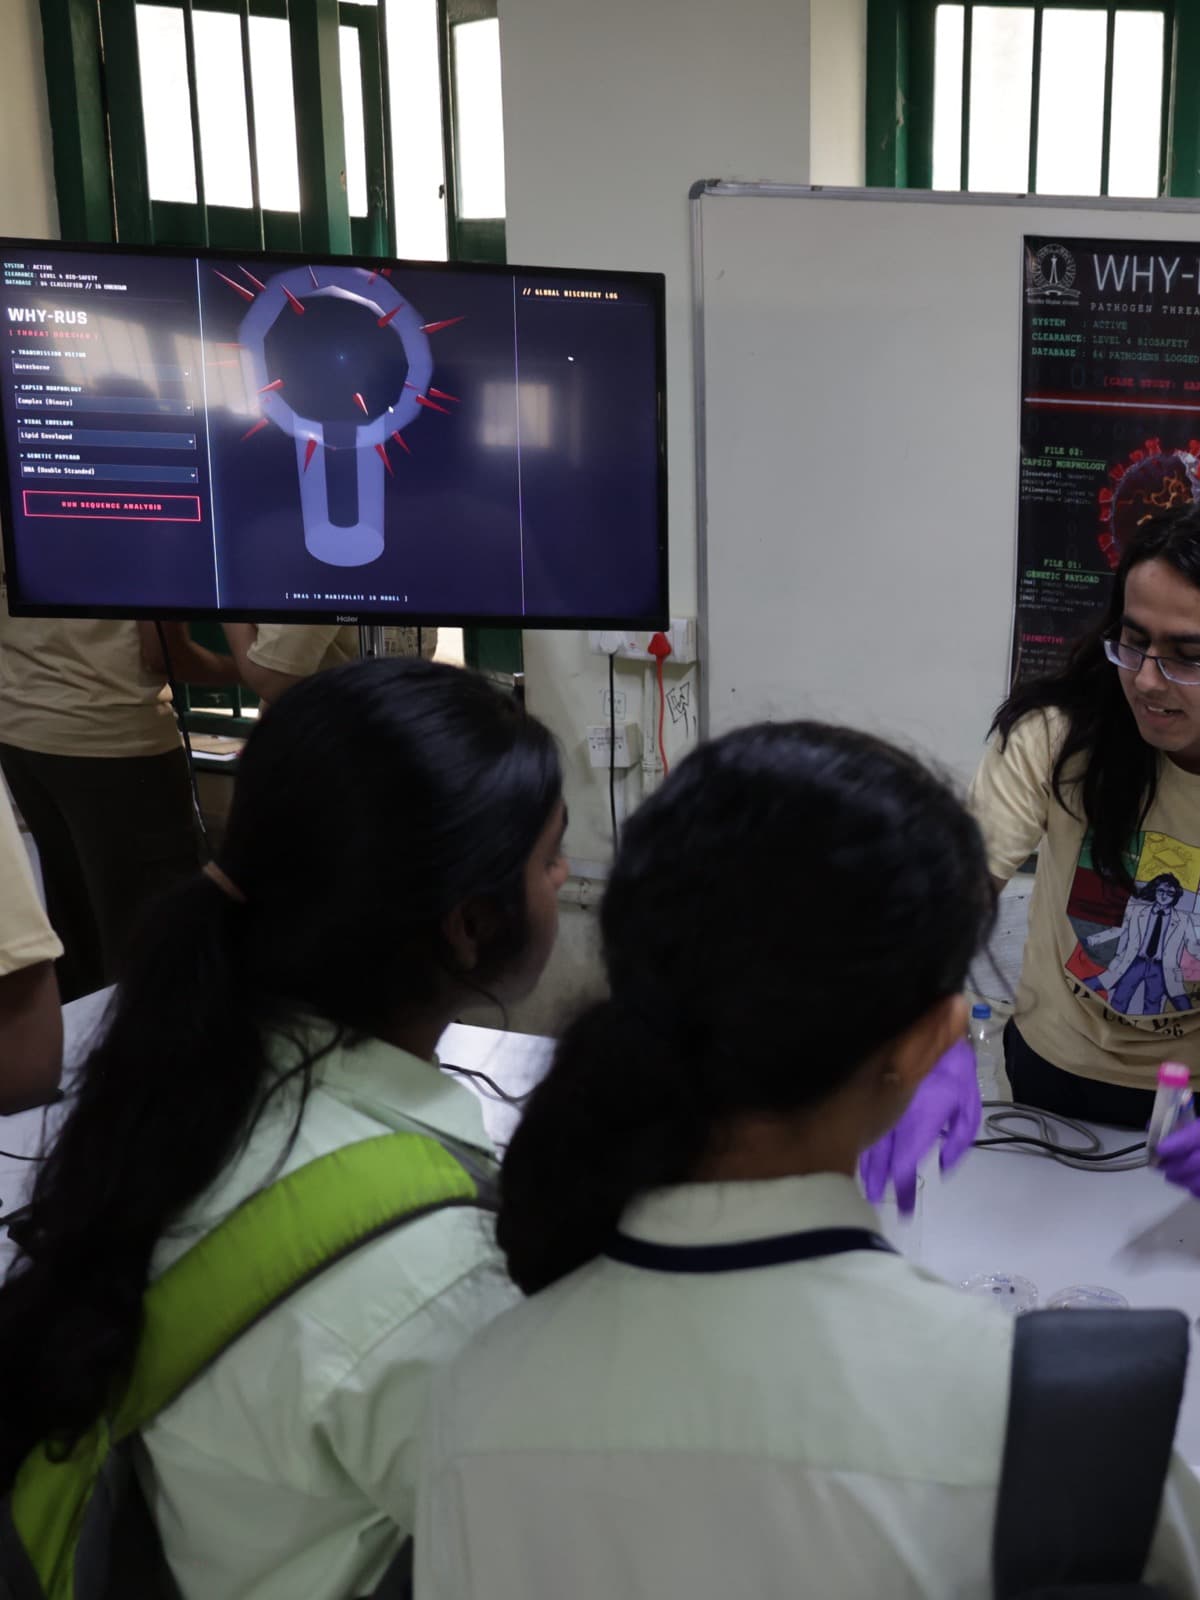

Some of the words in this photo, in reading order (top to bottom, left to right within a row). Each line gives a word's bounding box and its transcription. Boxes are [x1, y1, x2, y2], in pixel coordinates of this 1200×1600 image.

[1091, 303, 1152, 313] PATHOGEN
[8, 308, 88, 325] WHY-RUS
[1031, 318, 1066, 327] SYSTEM
[1093, 320, 1128, 330] ACTIVE
[1093, 336, 1120, 345] LEVEL
[1137, 338, 1189, 349] BIOSAFETY
[1031, 347, 1077, 358] DATABASE
[1109, 351, 1160, 362] PATHOGENS
[1165, 353, 1200, 364] LOGGED
[21, 431, 39, 440] Lipid
[1044, 446, 1065, 455] FILE
[1022, 458, 1053, 468] CAPSID
[1056, 460, 1106, 471] MORPHOLOGY
[1044, 559, 1065, 568] FILE
[1026, 570, 1061, 581] GENETIC
[1065, 573, 1100, 584] PAYLOAD
